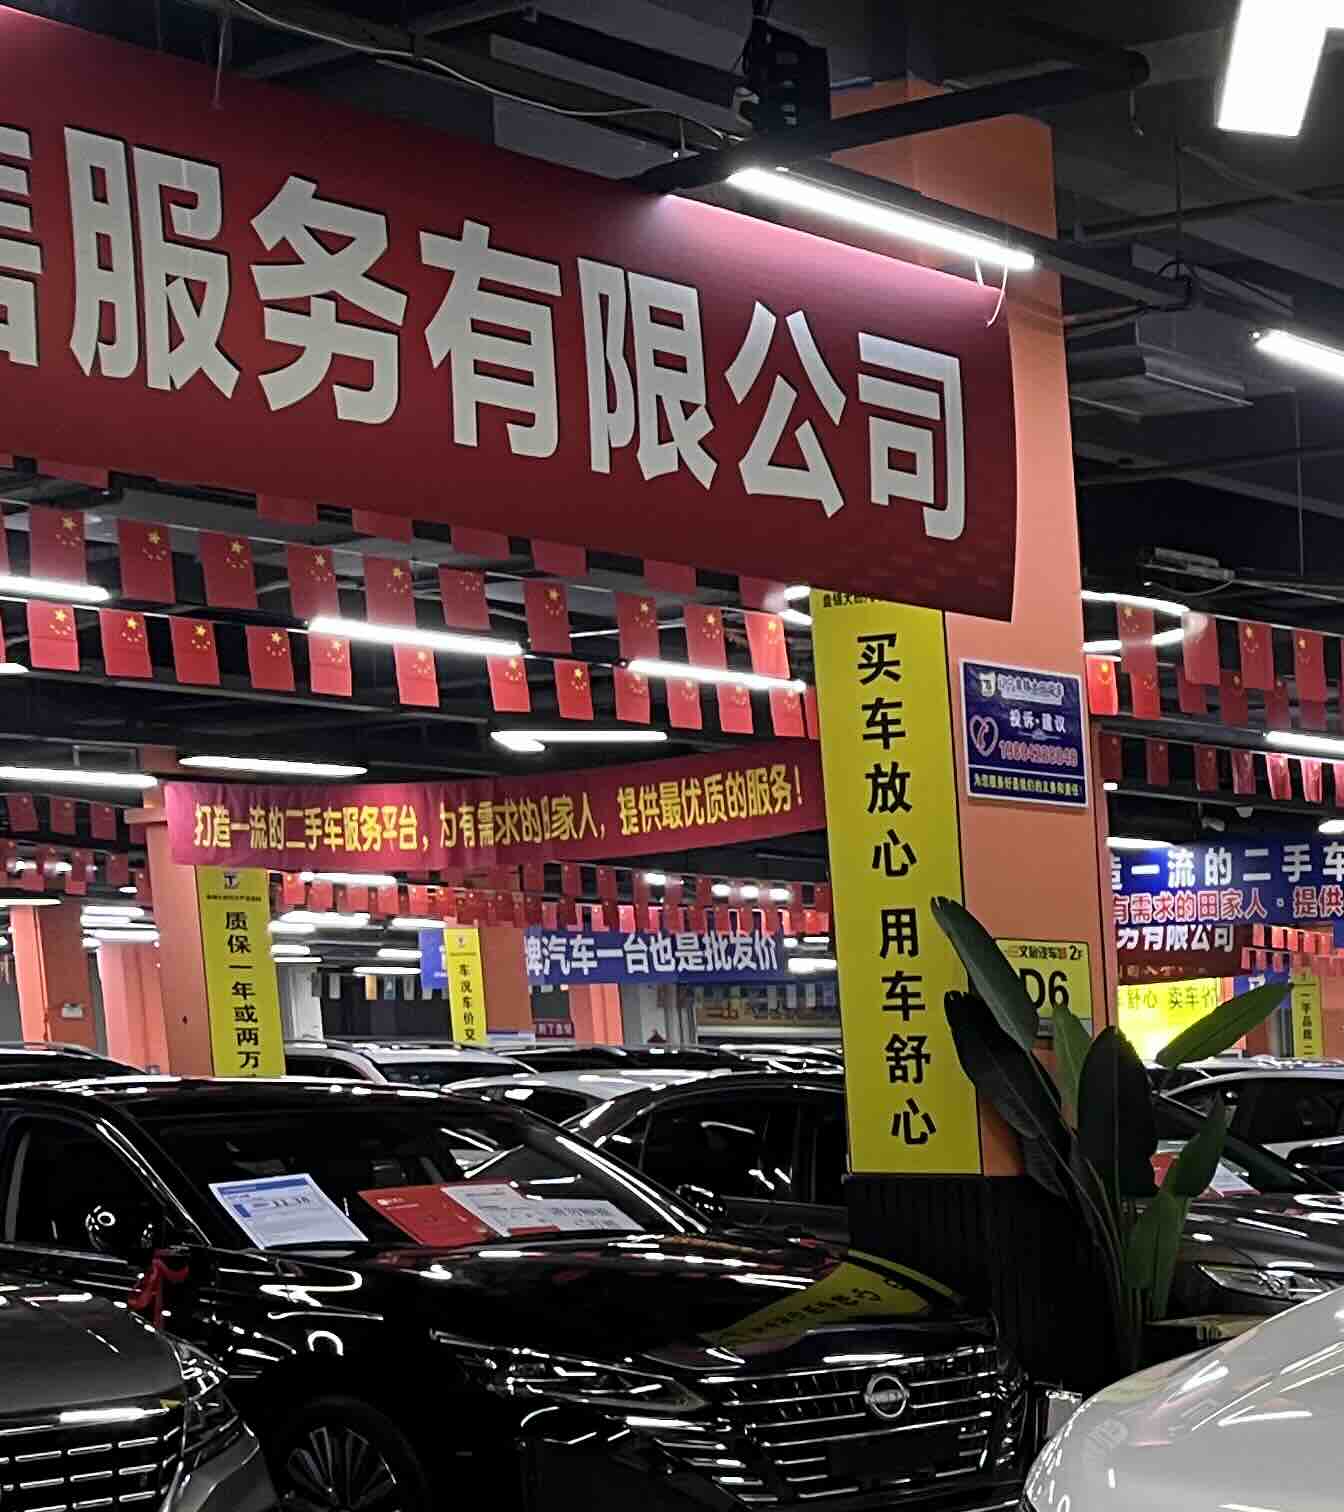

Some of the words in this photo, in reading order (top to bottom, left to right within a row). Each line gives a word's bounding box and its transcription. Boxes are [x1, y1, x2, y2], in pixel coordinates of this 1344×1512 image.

[0, 126, 966, 540] 服务有限公司
[857, 633, 917, 878] 买车放心
[879, 908, 937, 1146] 用车舒心
